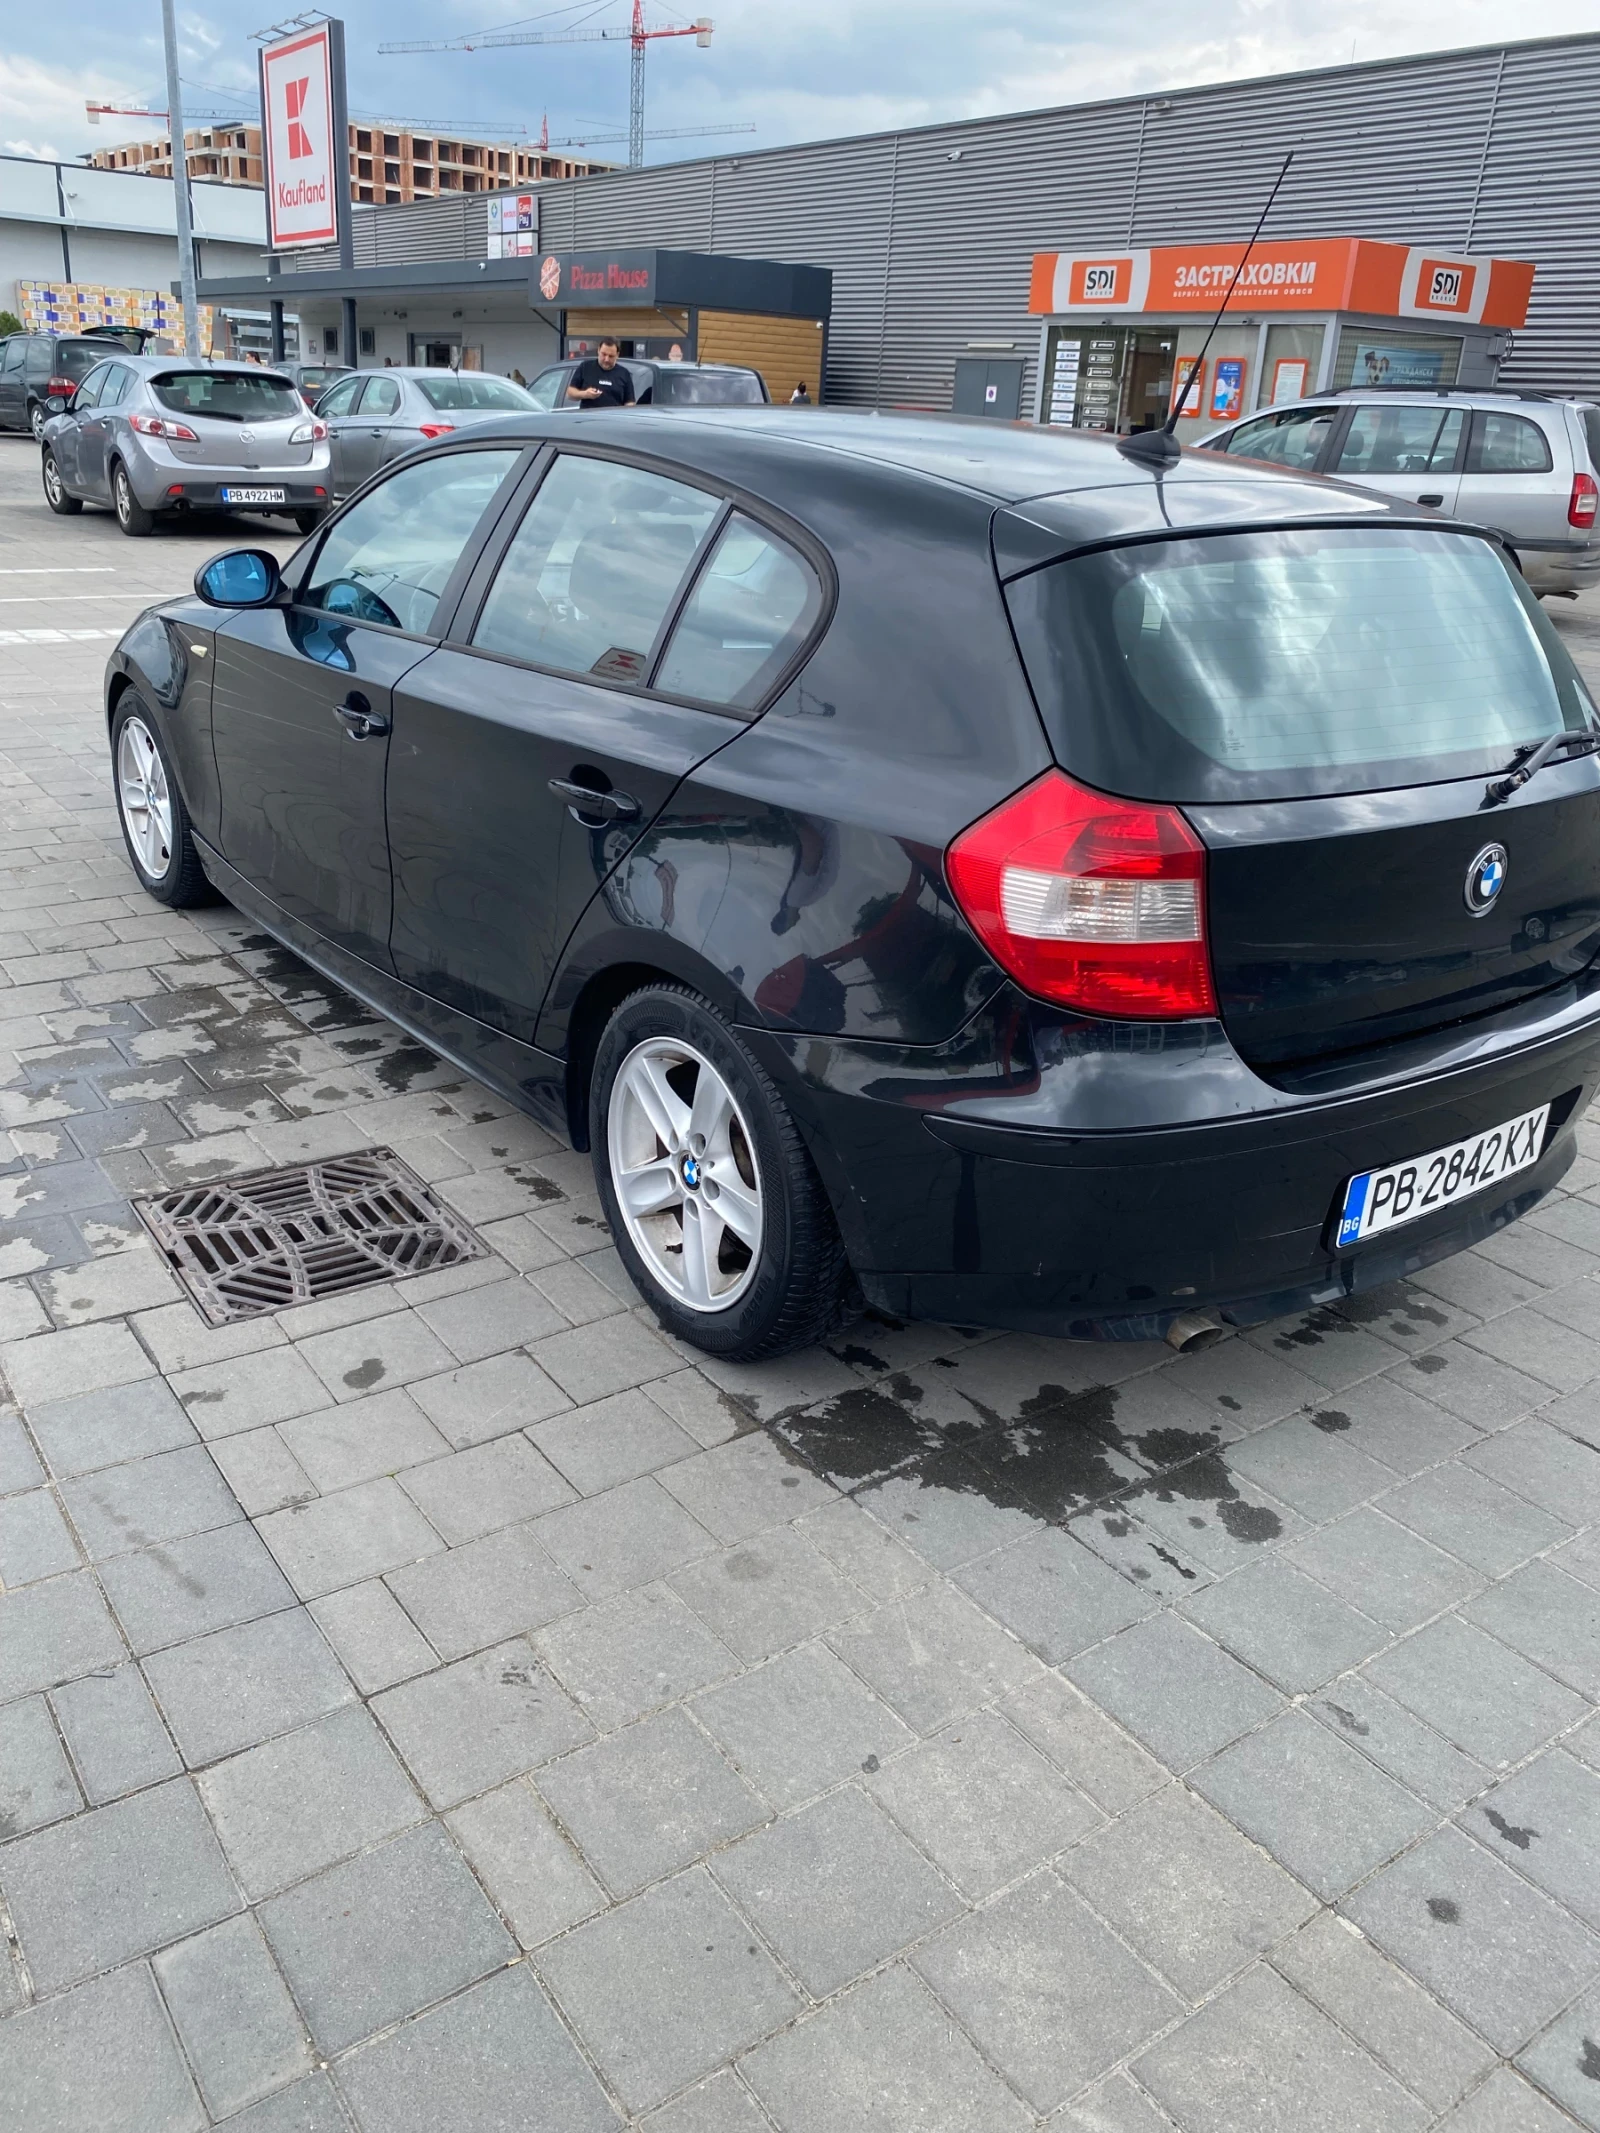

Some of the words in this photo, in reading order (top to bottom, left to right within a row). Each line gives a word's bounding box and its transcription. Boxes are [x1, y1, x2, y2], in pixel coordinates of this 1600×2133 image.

[278, 175, 326, 209] Kaufland
[518, 202, 532, 214] Easy
[518, 214, 530, 227] Pay
[571, 266, 604, 290] Pizza
[607, 264, 649, 289] House
[1086, 270, 1115, 290] SDI
[1174, 261, 1317, 288] ЗАСТРАХОВКИ
[1433, 272, 1460, 296] SDI
[229, 490, 243, 501] PB
[245, 490, 269, 501] 4922
[271, 491, 284, 502] HM
[1367, 1166, 1418, 1227] PB
[1420, 1132, 1502, 1207] 2842
[1501, 1111, 1544, 1173] KX
[1343, 1216, 1361, 1235] BG
